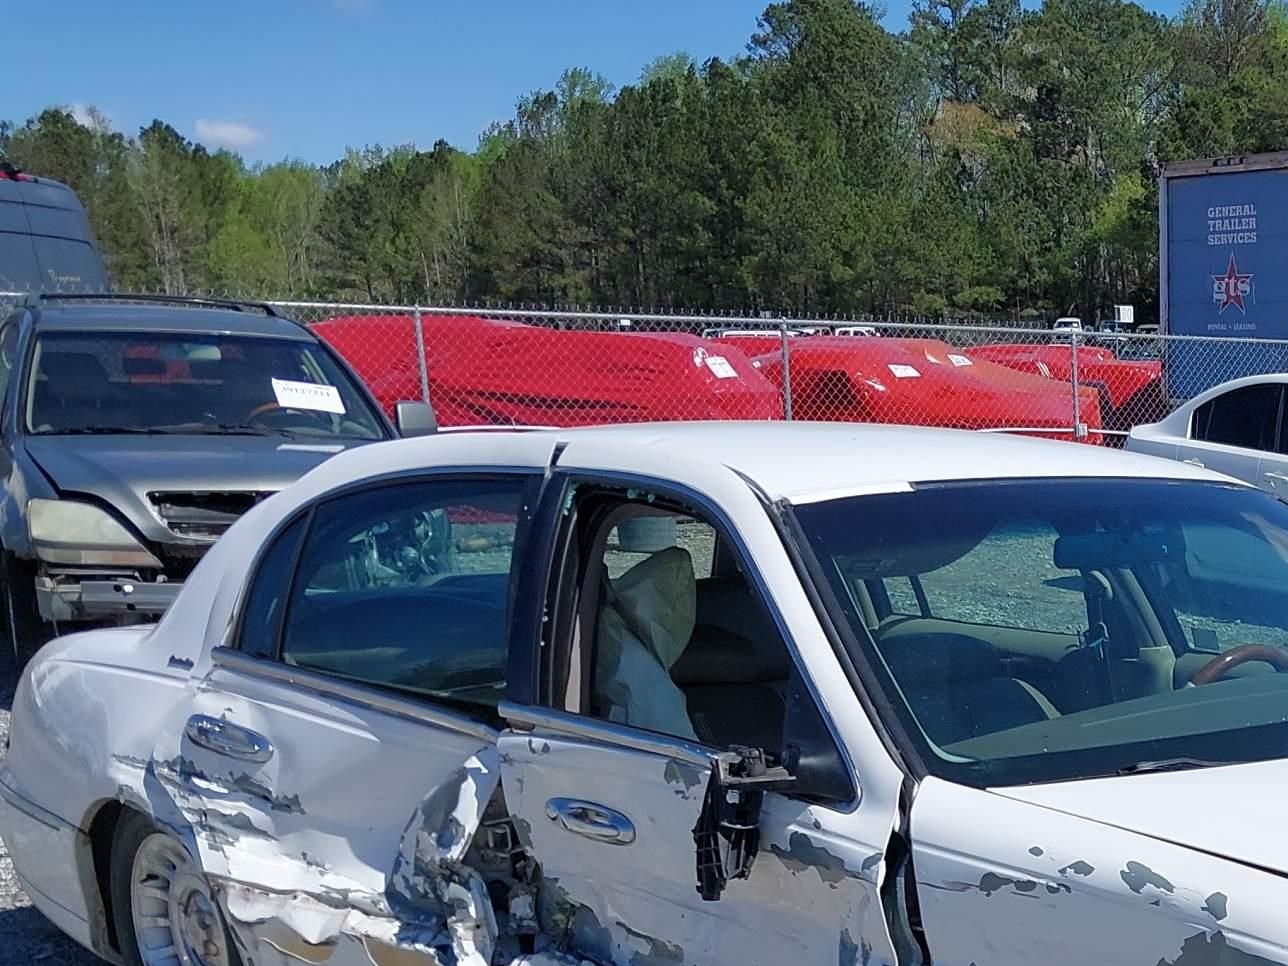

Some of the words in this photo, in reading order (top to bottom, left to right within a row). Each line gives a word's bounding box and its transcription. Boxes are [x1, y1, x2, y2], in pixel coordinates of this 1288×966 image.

[1207, 204, 1257, 218] GENERAL
[1207, 217, 1256, 232] TRAILER
[1207, 232, 1257, 246] SERVICES
[1207, 323, 1228, 331] RENTAL
[1233, 322, 1257, 331] LEASING
